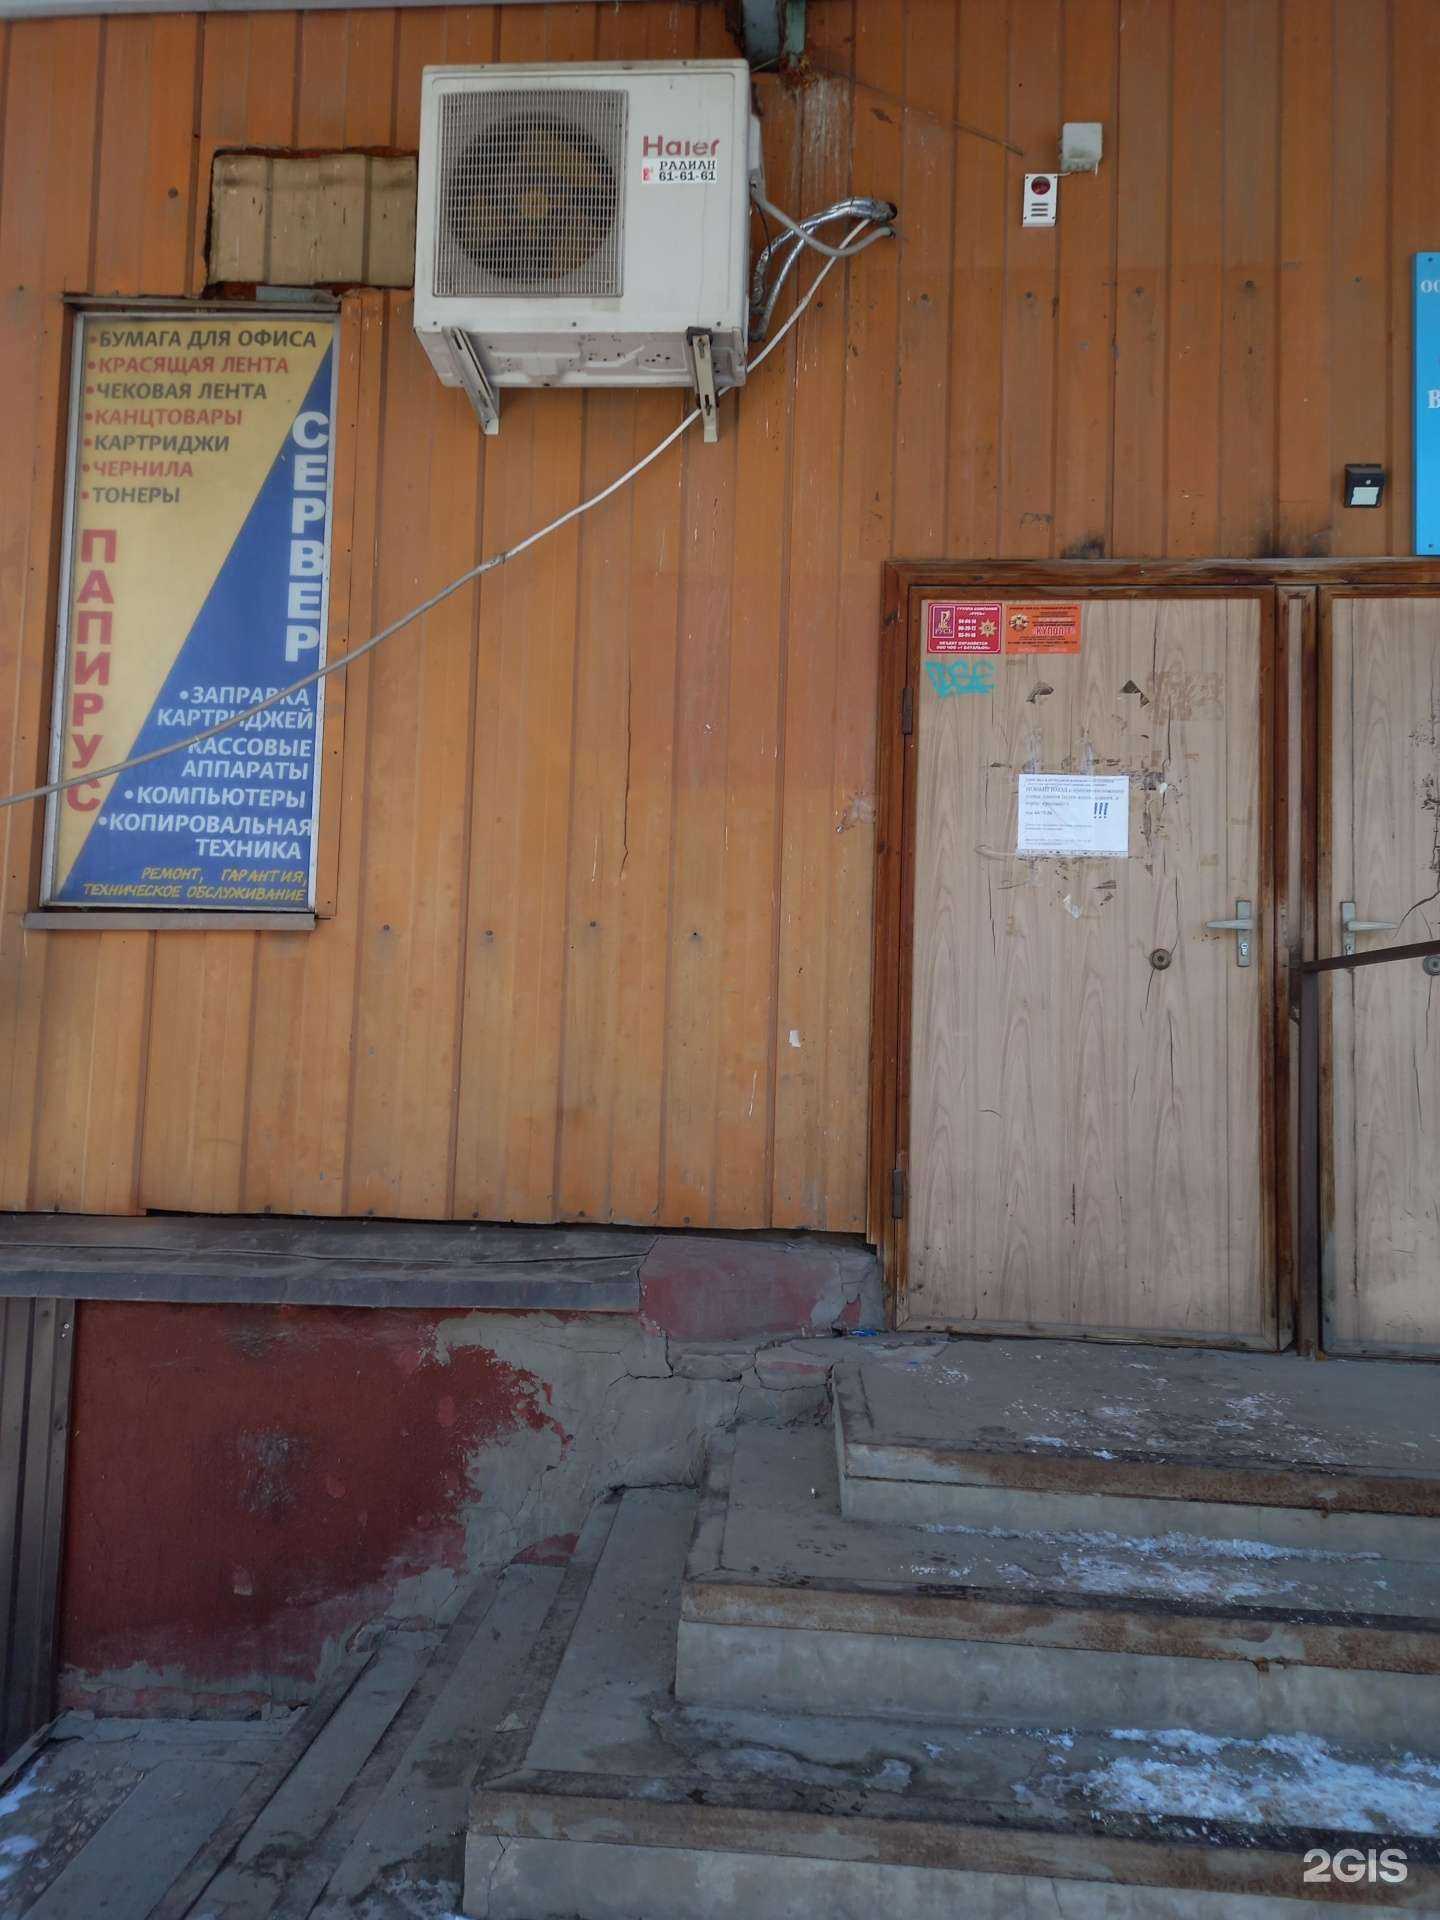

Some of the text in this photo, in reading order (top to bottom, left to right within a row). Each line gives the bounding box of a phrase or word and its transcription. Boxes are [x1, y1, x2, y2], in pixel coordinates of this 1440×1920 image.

[643, 135, 720, 157] Haier
[659, 171, 716, 181] 61-61-61
[100, 330, 317, 350] БУМАГА ДЛЯ ОФИСА
[100, 356, 289, 376] КРАСЯЩАЯ ЛЕНТА
[97, 383, 267, 399] ЧЕКОВАЯ ЛЕНТА
[95, 409, 242, 428] КАНЦТОВАРЫ
[94, 435, 229, 455] КАРТРИДЖИ
[94, 461, 193, 478] ЧЕРНИЛА
[93, 487, 180, 503] ТОНЕРЫ
[285, 411, 330, 662] СЕРВЕР
[66, 528, 118, 812] ПАПИРУС
[181, 760, 308, 780] АППАРАТЫ
[137, 786, 306, 809] КОМПЬЮТЕРЫ
[109, 813, 313, 837] КОПИРОВАЛЬНАЯ
[195, 838, 302, 860] ТЕХНИКА
[141, 867, 308, 886] РЕМОНТ, ГАРАНТИЯ,
[83, 882, 305, 901] ТЕХНИЧЕСКОЕ ОБСЛУЖИВАНИЕ
